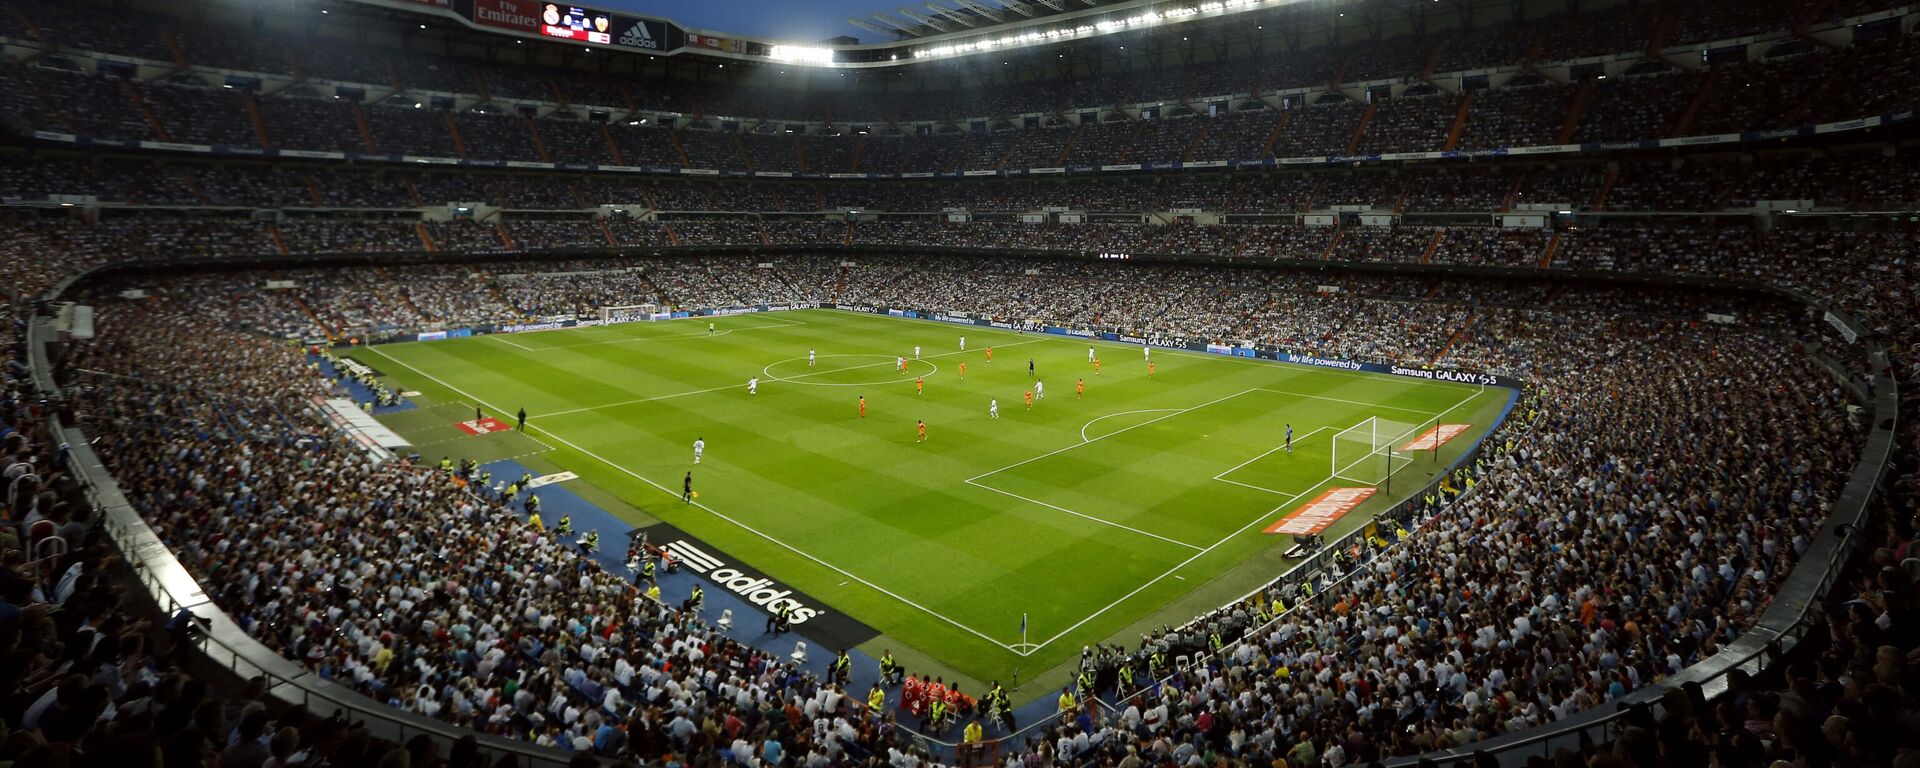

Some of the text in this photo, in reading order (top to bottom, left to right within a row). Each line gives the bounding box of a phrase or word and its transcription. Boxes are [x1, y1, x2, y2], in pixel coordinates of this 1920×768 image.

[500, 1, 517, 13] Fly
[478, 6, 537, 27] Emirates
[620, 35, 657, 49] adidas
[502, 325, 514, 333] My
[514, 324, 524, 332] life
[526, 322, 554, 332] powered
[990, 321, 1012, 329] Samsung
[1013, 323, 1034, 331] GAAXY
[1120, 335, 1146, 344] Samsung
[1148, 338, 1174, 348] GALAXY
[1289, 354, 1362, 370] My life powered by
[1391, 366, 1432, 379] Samsung
[1436, 370, 1476, 382] GALAXY
[710, 568, 817, 625] adidas
